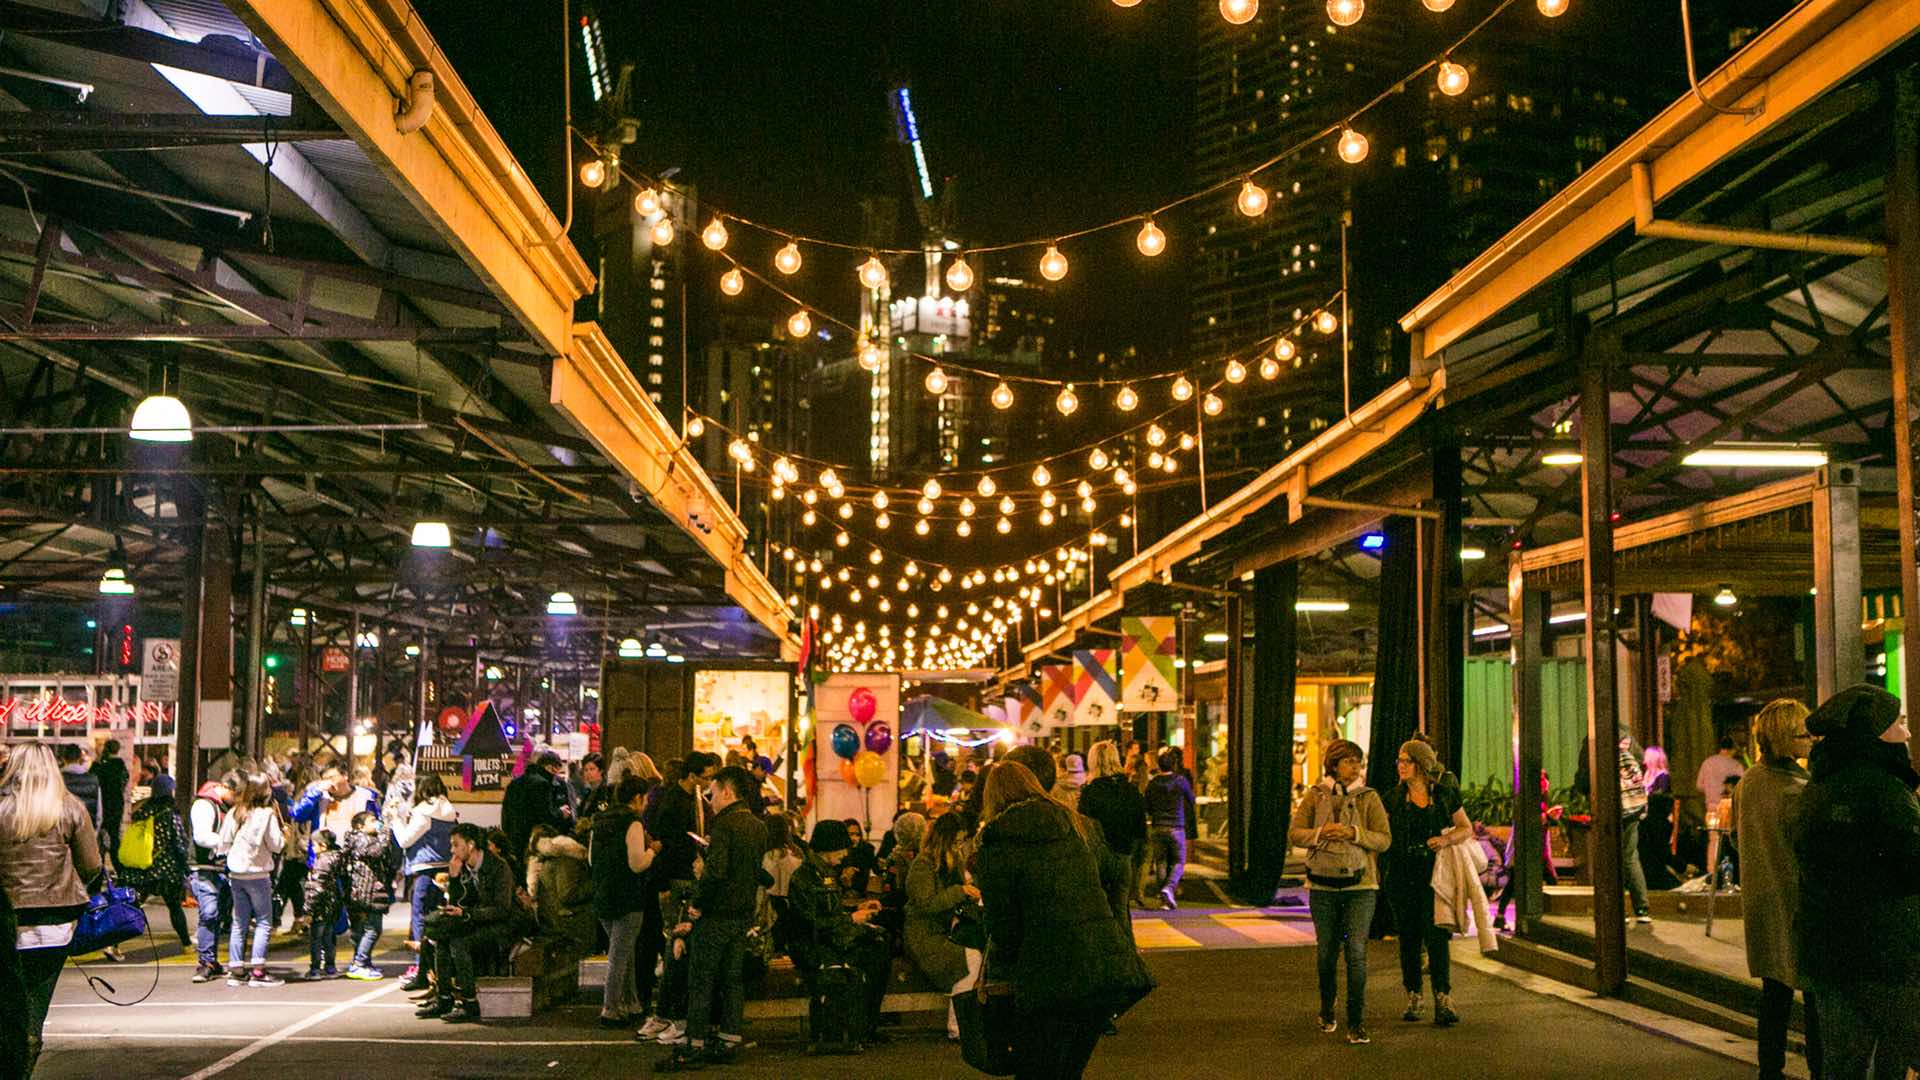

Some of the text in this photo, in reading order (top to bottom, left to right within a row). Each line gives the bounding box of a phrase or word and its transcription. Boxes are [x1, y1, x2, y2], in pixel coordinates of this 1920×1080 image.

[22, 695, 88, 723] Wine
[474, 758, 500, 771] TOILETS
[475, 773, 499, 785] ATM
